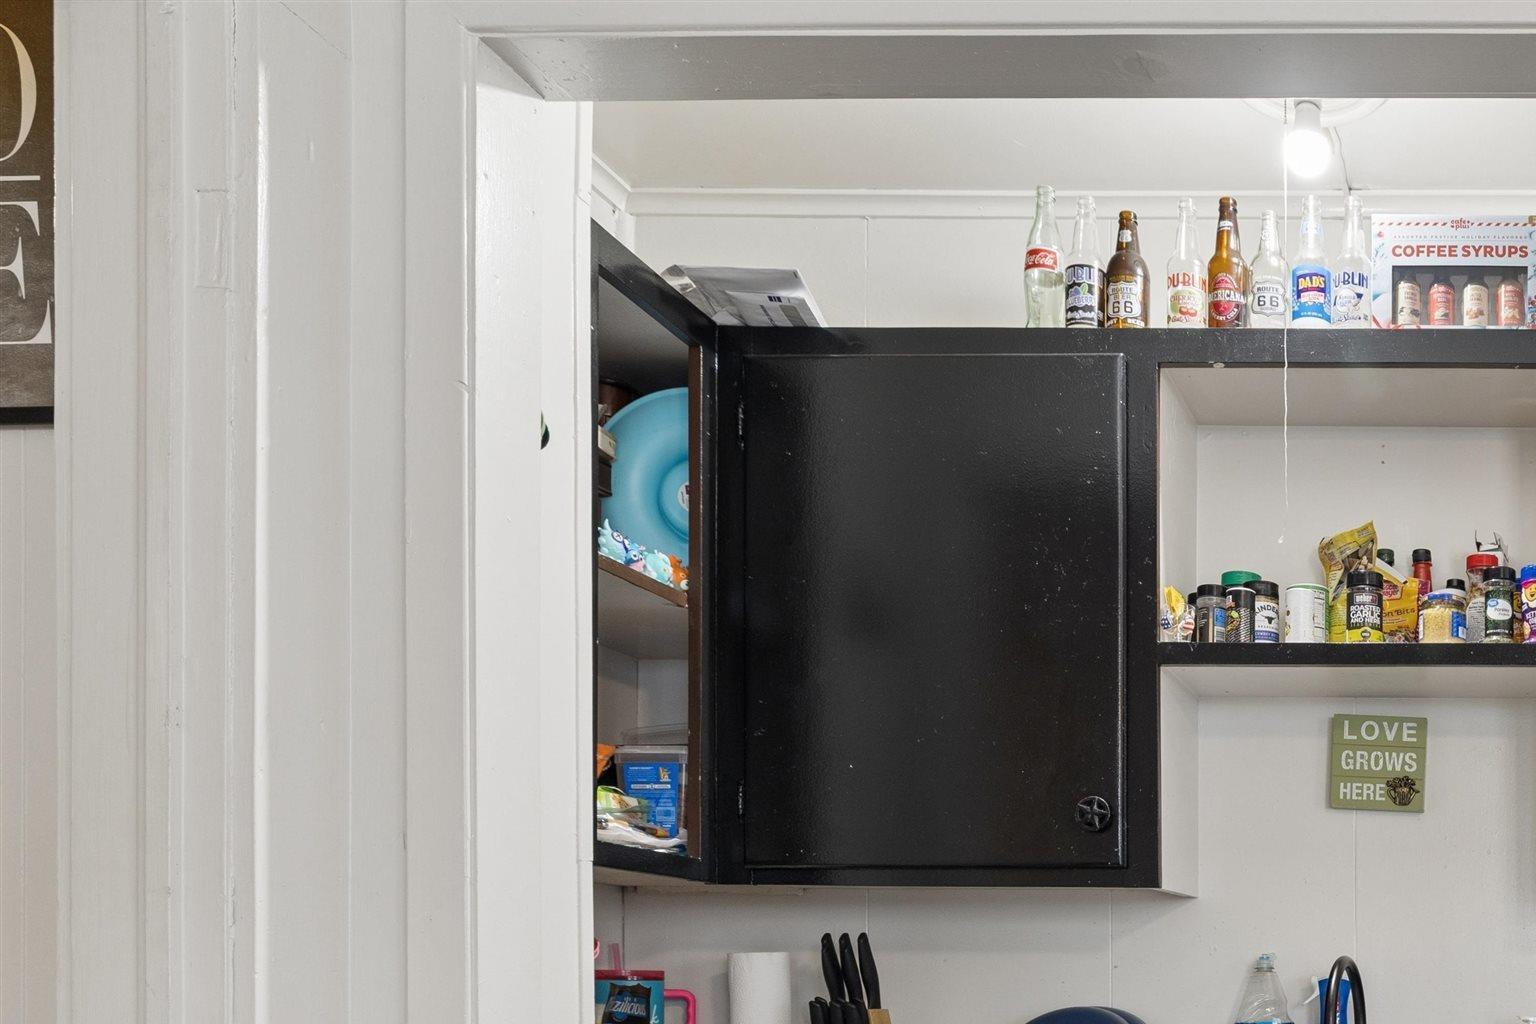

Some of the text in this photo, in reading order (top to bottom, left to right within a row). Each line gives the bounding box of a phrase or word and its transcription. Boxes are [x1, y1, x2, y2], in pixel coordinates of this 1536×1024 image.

[1391, 244, 1529, 259] COFFEE SYRUPS
[1298, 275, 1325, 290] DAD'S
[1334, 271, 1369, 289] UBLIN
[1256, 285, 1279, 293] ROUTE
[1112, 301, 1133, 314] 66
[1257, 295, 1279, 308] 66
[1350, 604, 1380, 612] ROASTED
[1343, 720, 1418, 742] LOVE
[1341, 749, 1417, 772] GROWS
[1339, 782, 1386, 801] HERE
